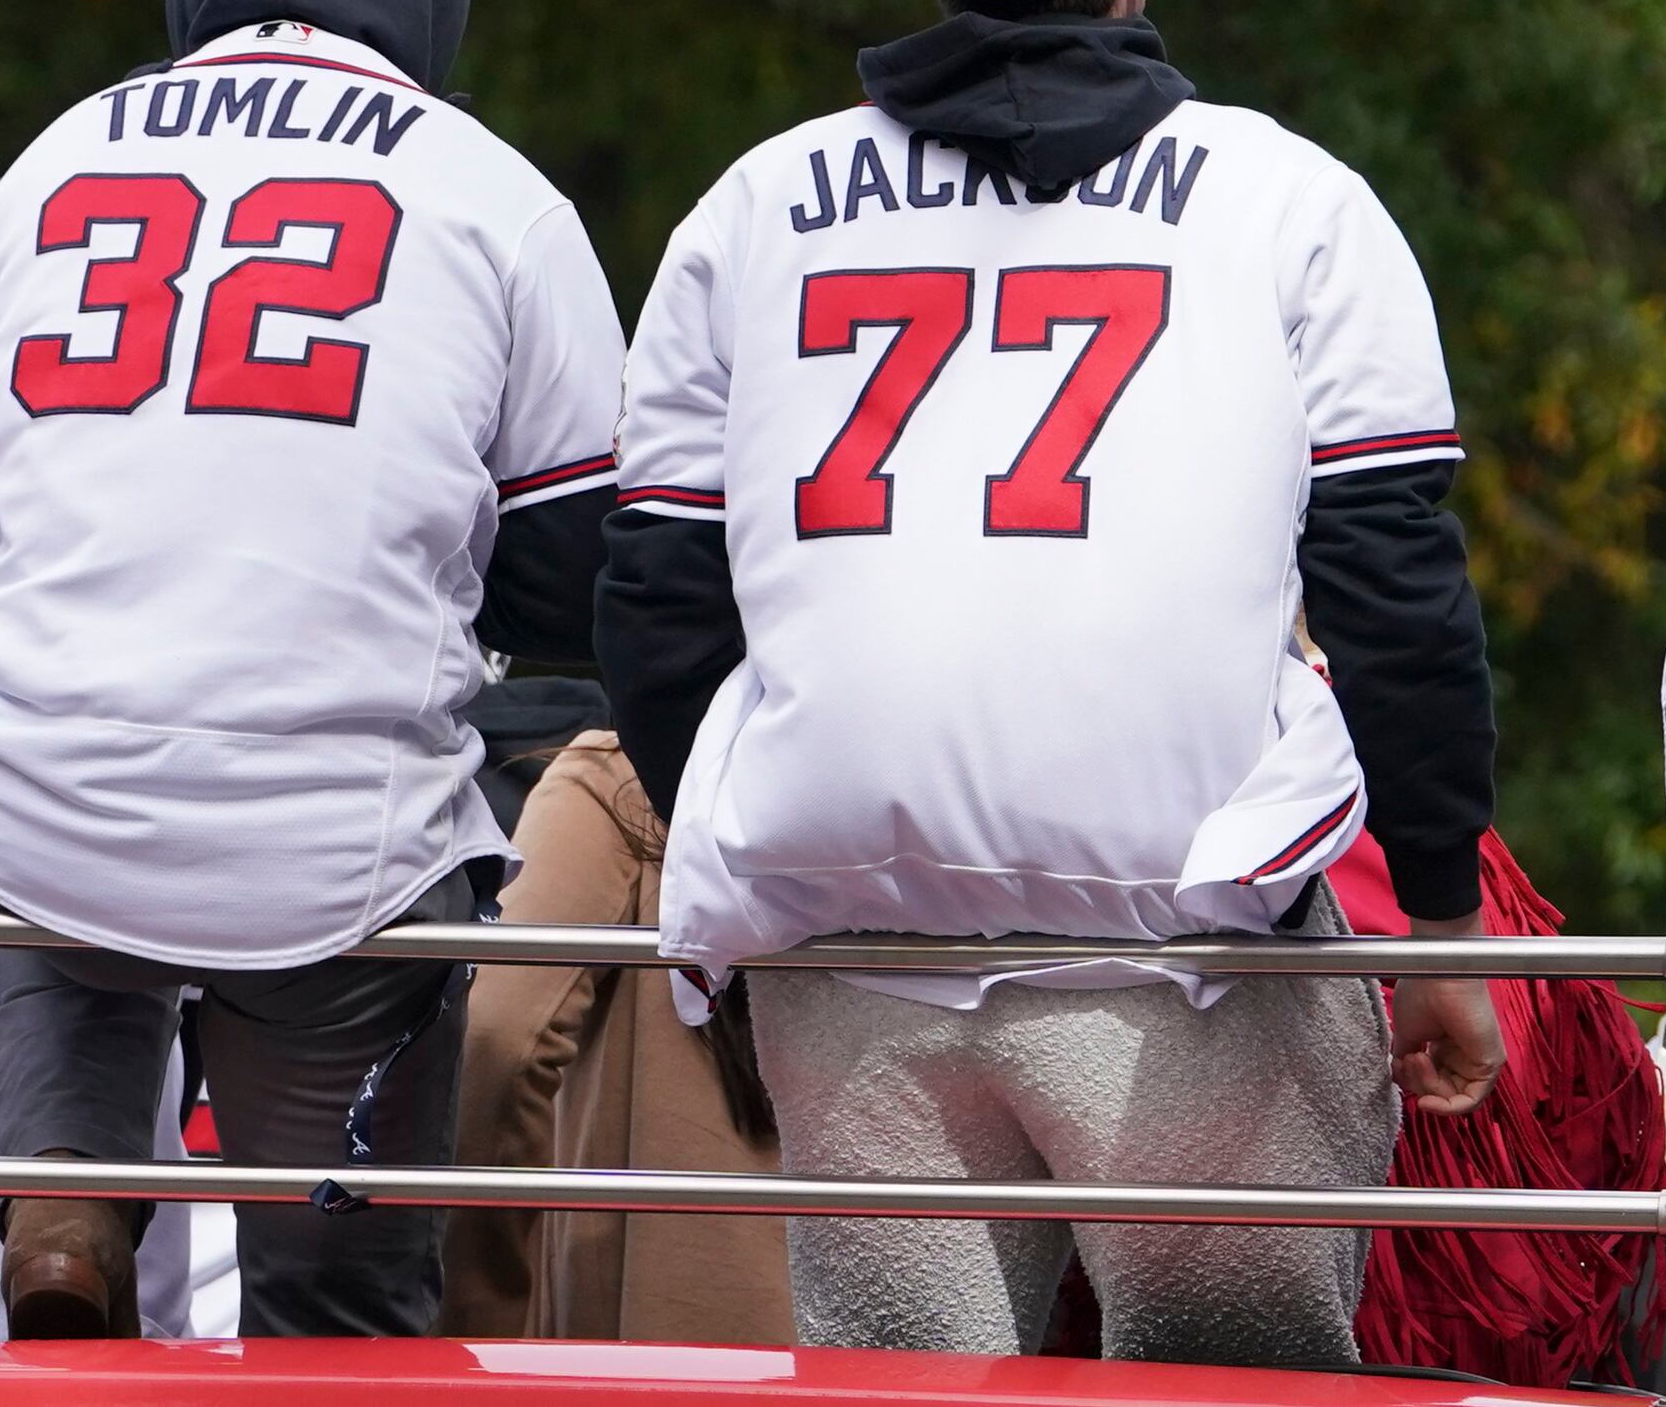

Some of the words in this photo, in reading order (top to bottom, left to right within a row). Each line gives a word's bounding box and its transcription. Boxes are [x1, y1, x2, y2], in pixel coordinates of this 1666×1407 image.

[100, 77, 427, 156] TOMLIN
[789, 131, 1210, 234] JACKON
[10, 173, 404, 427] 32
[795, 263, 1173, 541] 77
